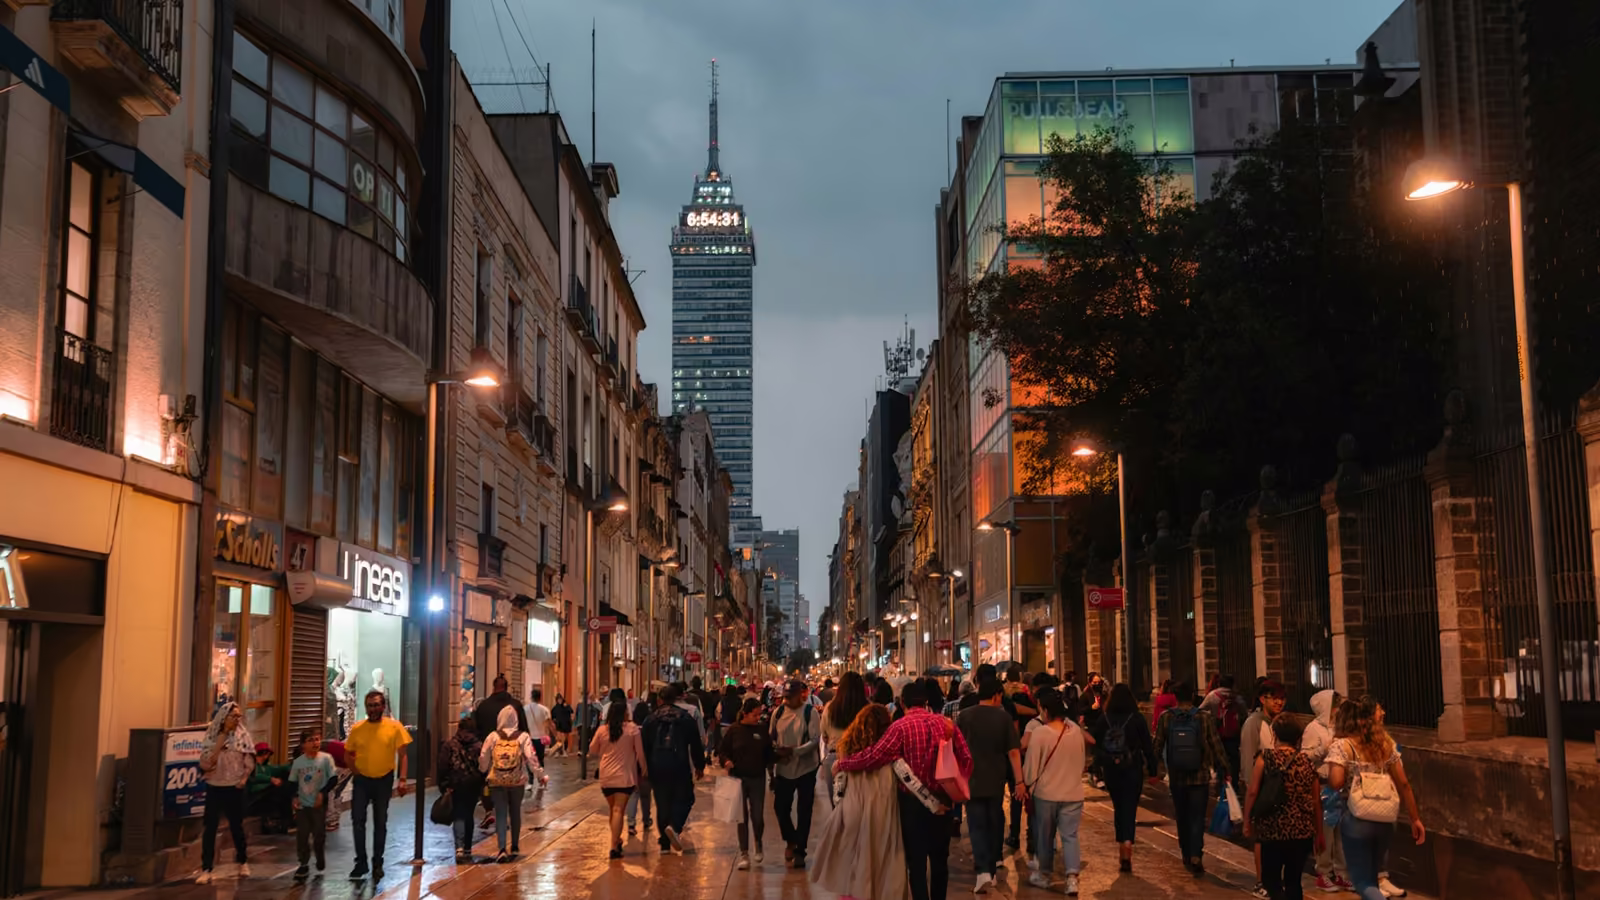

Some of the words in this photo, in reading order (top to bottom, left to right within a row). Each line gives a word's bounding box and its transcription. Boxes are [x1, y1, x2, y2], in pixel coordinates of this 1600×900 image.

[687, 211, 740, 227] 6:54:31
[291, 543, 308, 569] 47
[166, 766, 198, 791] 200
